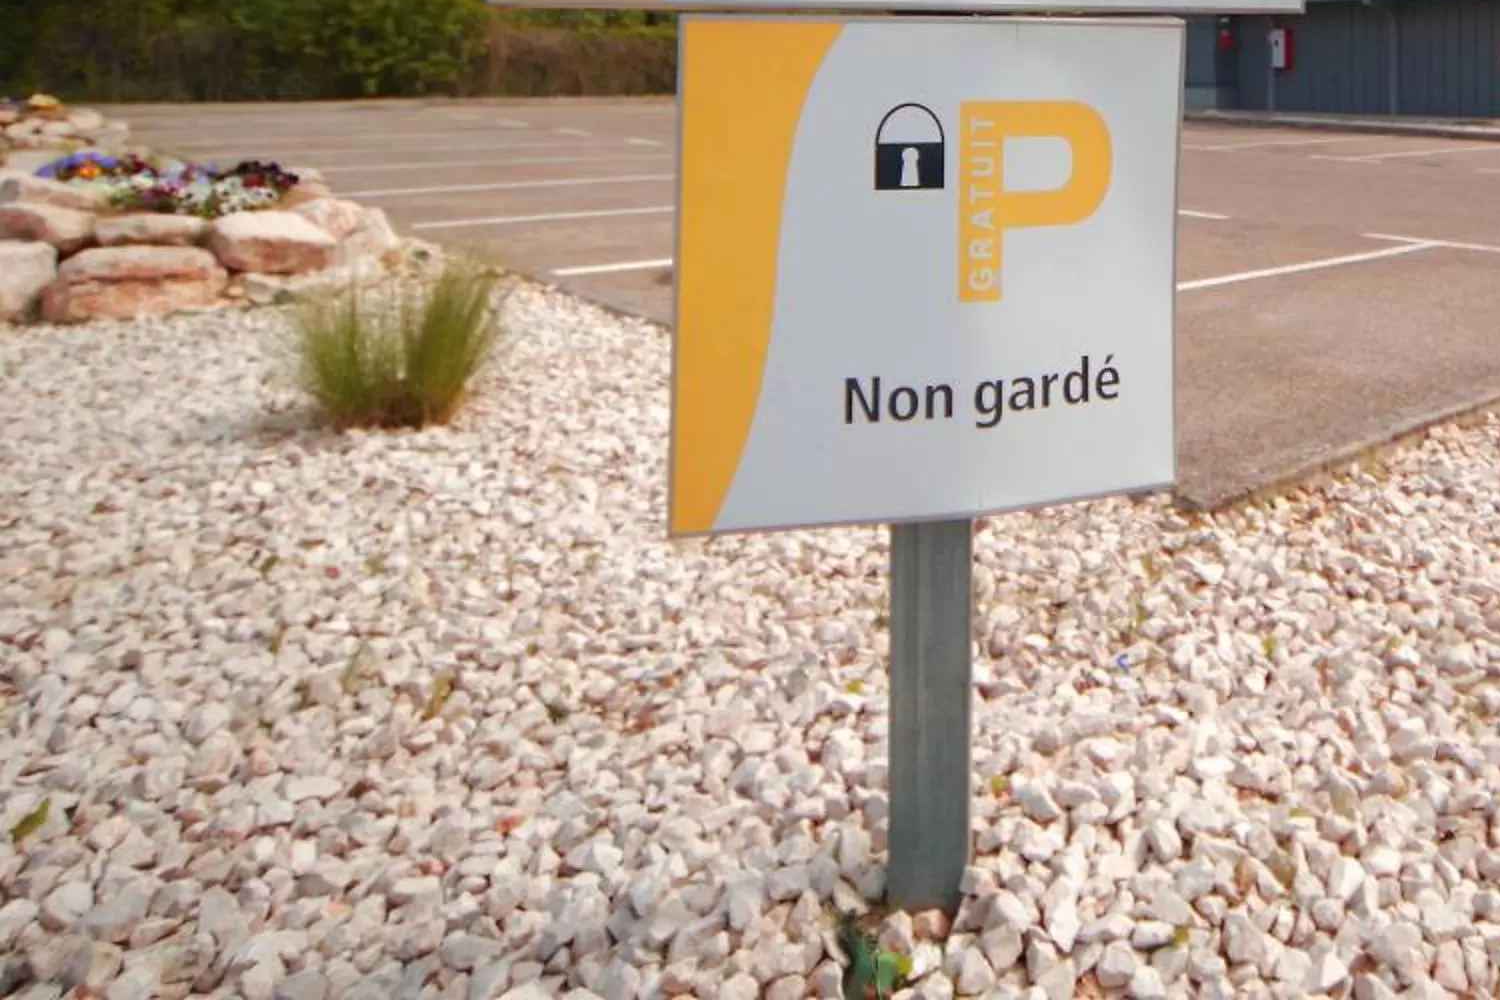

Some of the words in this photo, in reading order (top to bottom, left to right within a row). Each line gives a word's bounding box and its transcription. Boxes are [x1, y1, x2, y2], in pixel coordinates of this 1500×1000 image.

[959, 100, 1113, 302] P
[967, 117, 996, 292] GRATUIT
[844, 376, 953, 424] Non
[973, 354, 1121, 428] gardé
